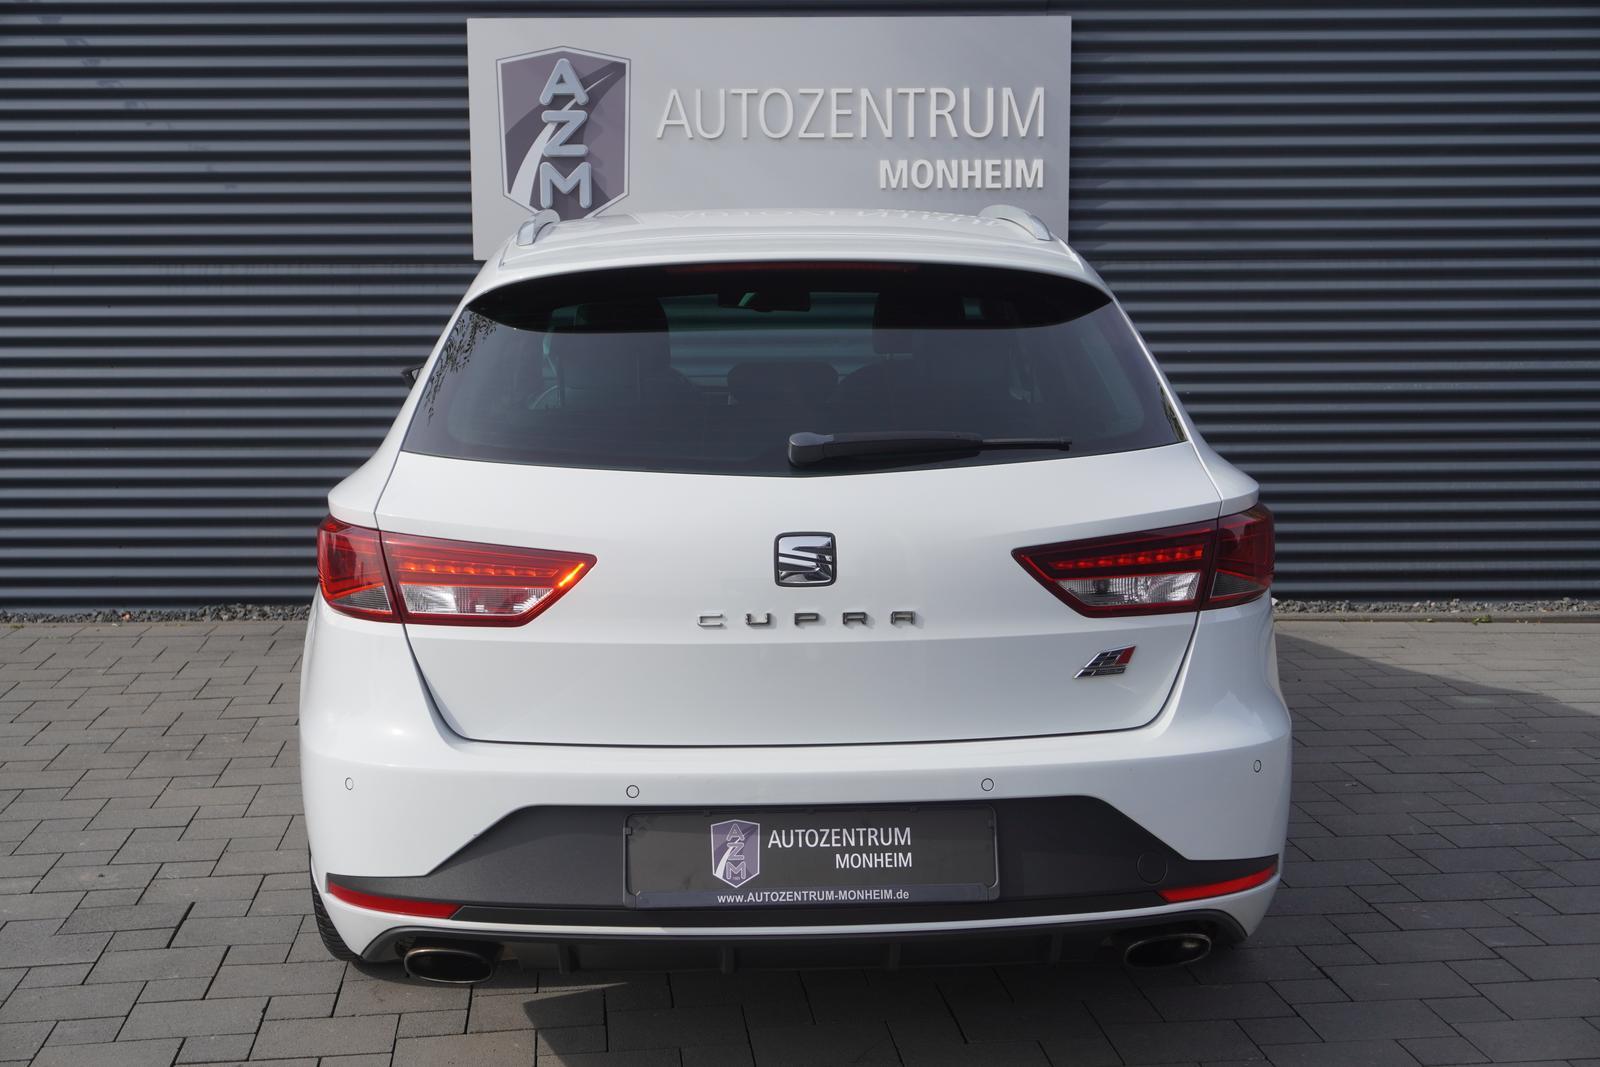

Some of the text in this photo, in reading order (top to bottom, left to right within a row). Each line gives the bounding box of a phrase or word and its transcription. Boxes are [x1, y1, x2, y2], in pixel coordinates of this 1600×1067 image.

[656, 85, 1046, 140] AUTOZENTRUM
[539, 57, 592, 209] AZM
[878, 158, 1045, 191] MONHEIM
[697, 611, 916, 628] CUPRA
[767, 827, 911, 848] AUTOZENTRUM
[726, 823, 746, 880] AZM
[835, 853, 912, 869] MONHEIM
[717, 888, 910, 903] www.AUTOZENTRUM-MONHEIM.de
